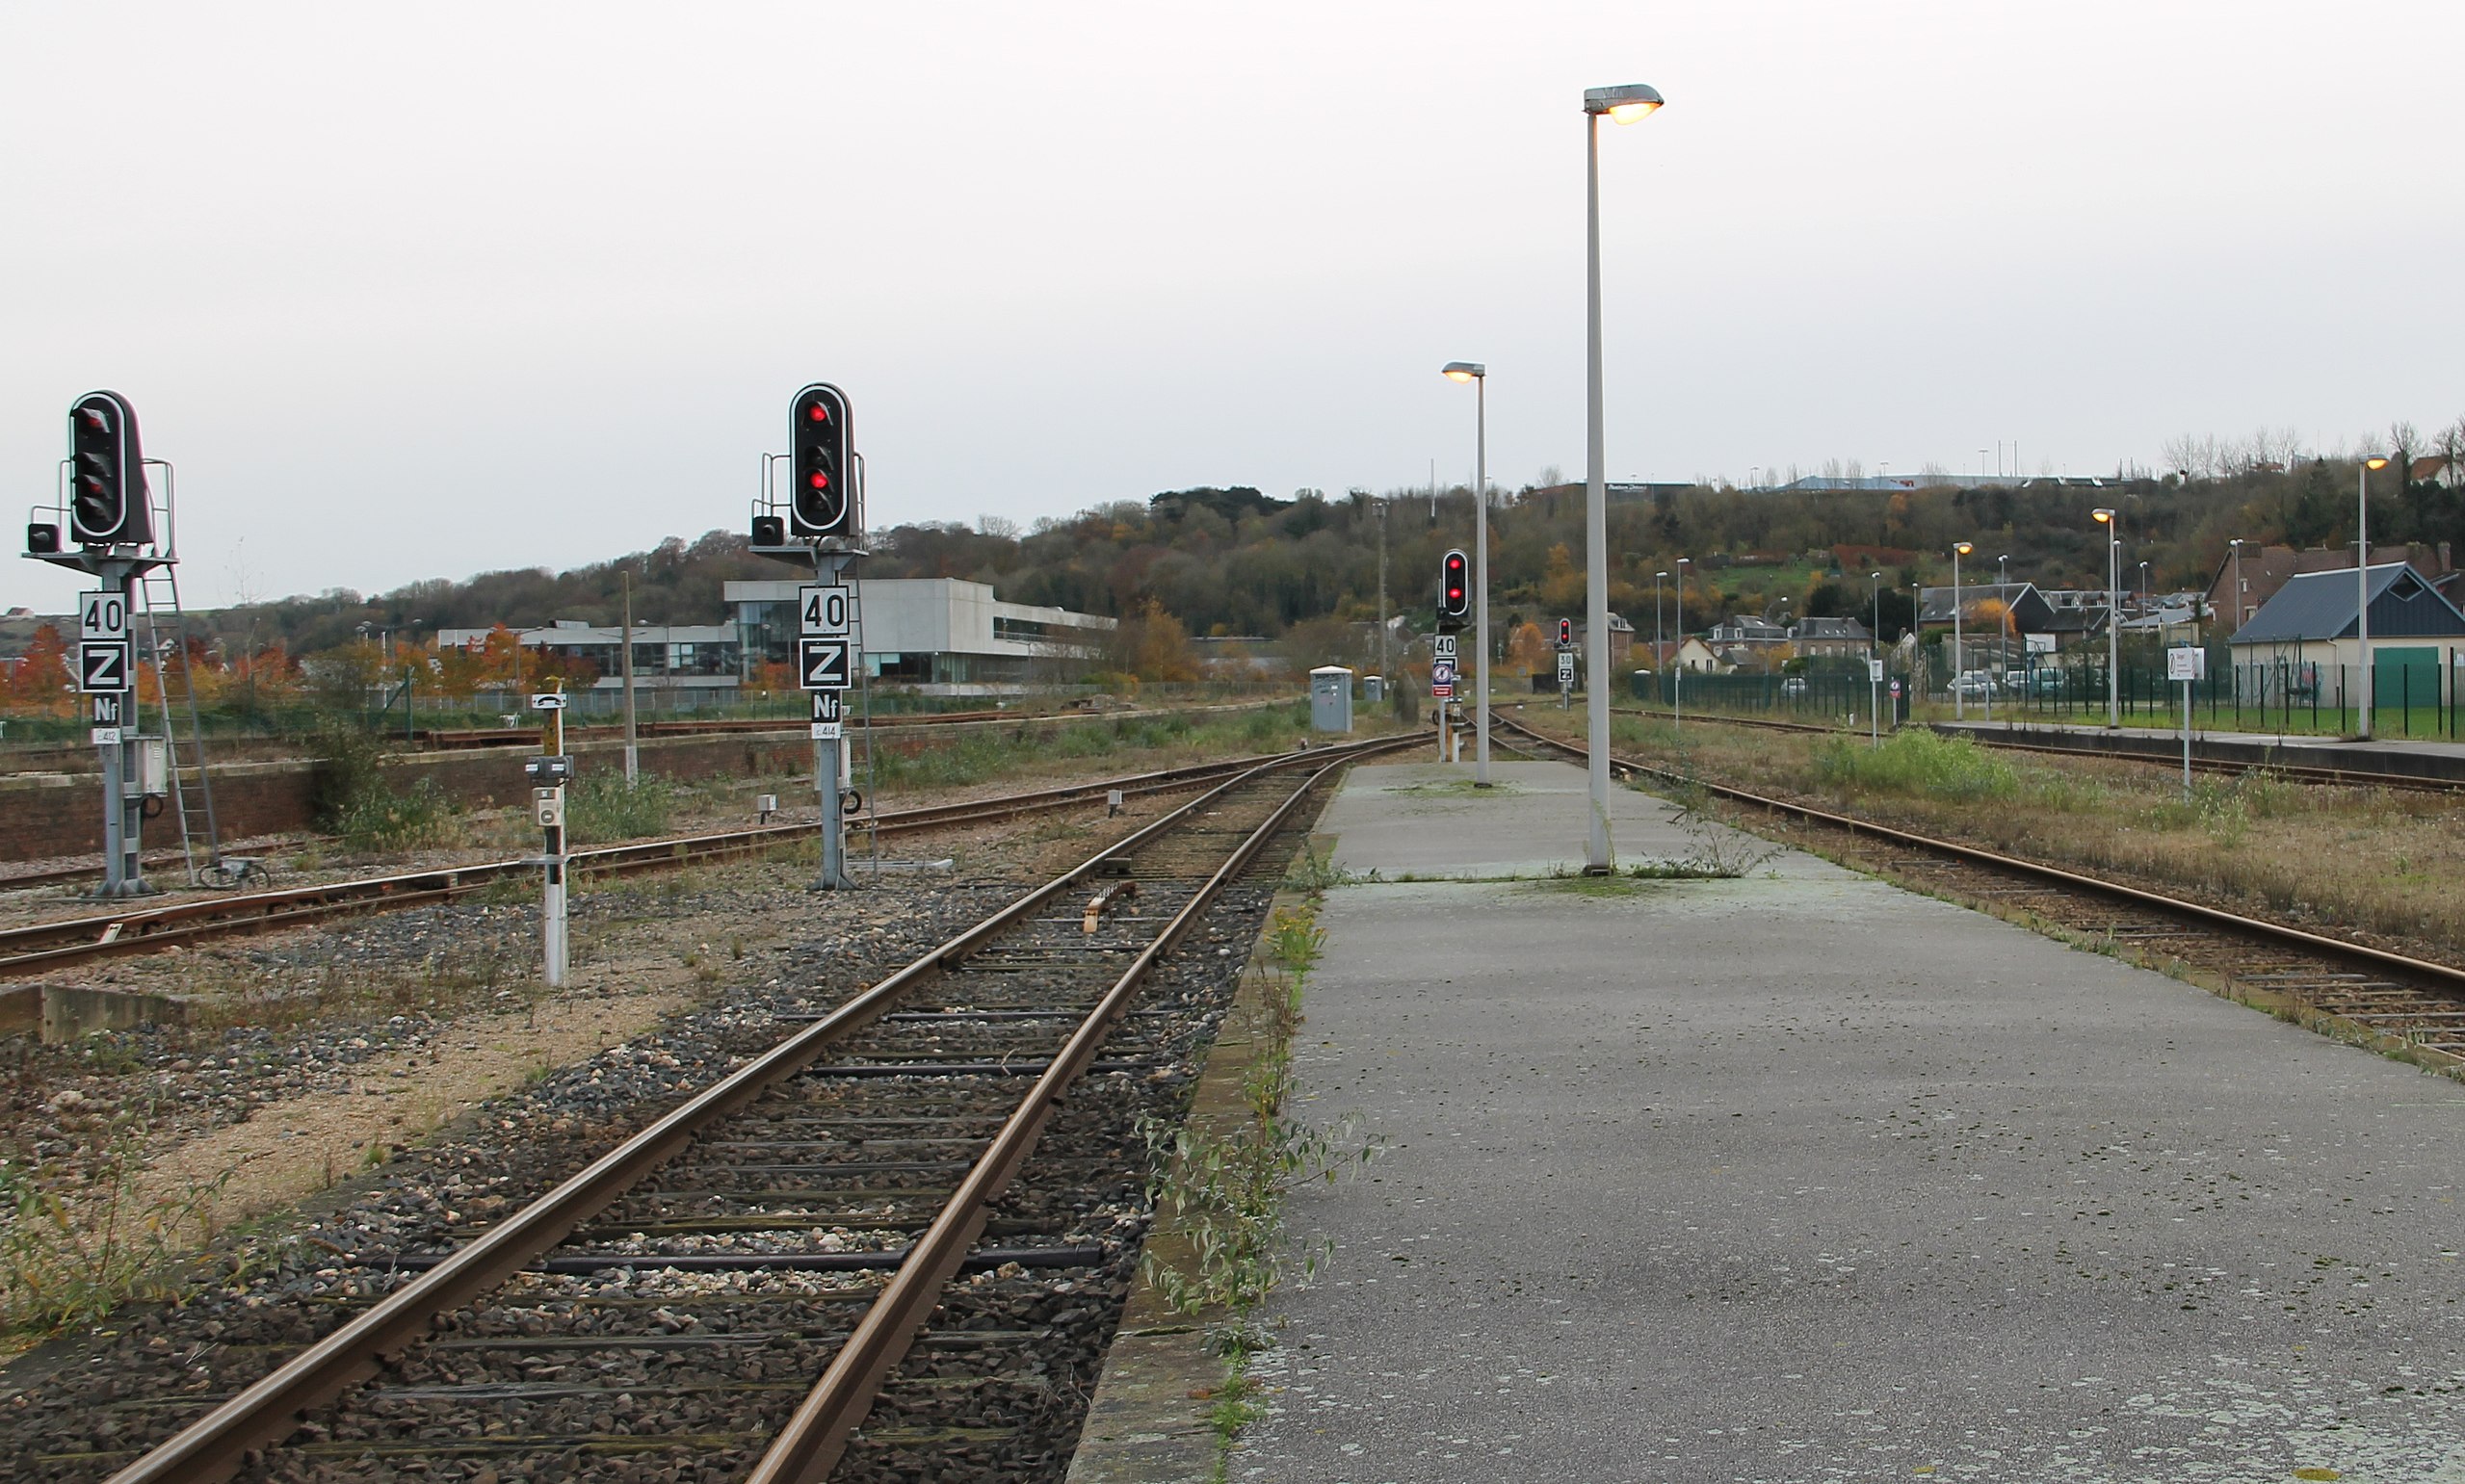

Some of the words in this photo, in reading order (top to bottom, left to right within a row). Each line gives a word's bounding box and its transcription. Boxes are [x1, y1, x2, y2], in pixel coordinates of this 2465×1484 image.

[85, 599, 122, 633] 40
[804, 594, 844, 627] 40
[1436, 638, 1455, 653] 40
[1560, 655, 1571, 664] 30
[88, 649, 119, 685] Z
[809, 645, 842, 681] Z
[94, 697, 118, 721] Nf
[814, 693, 838, 718] Nf
